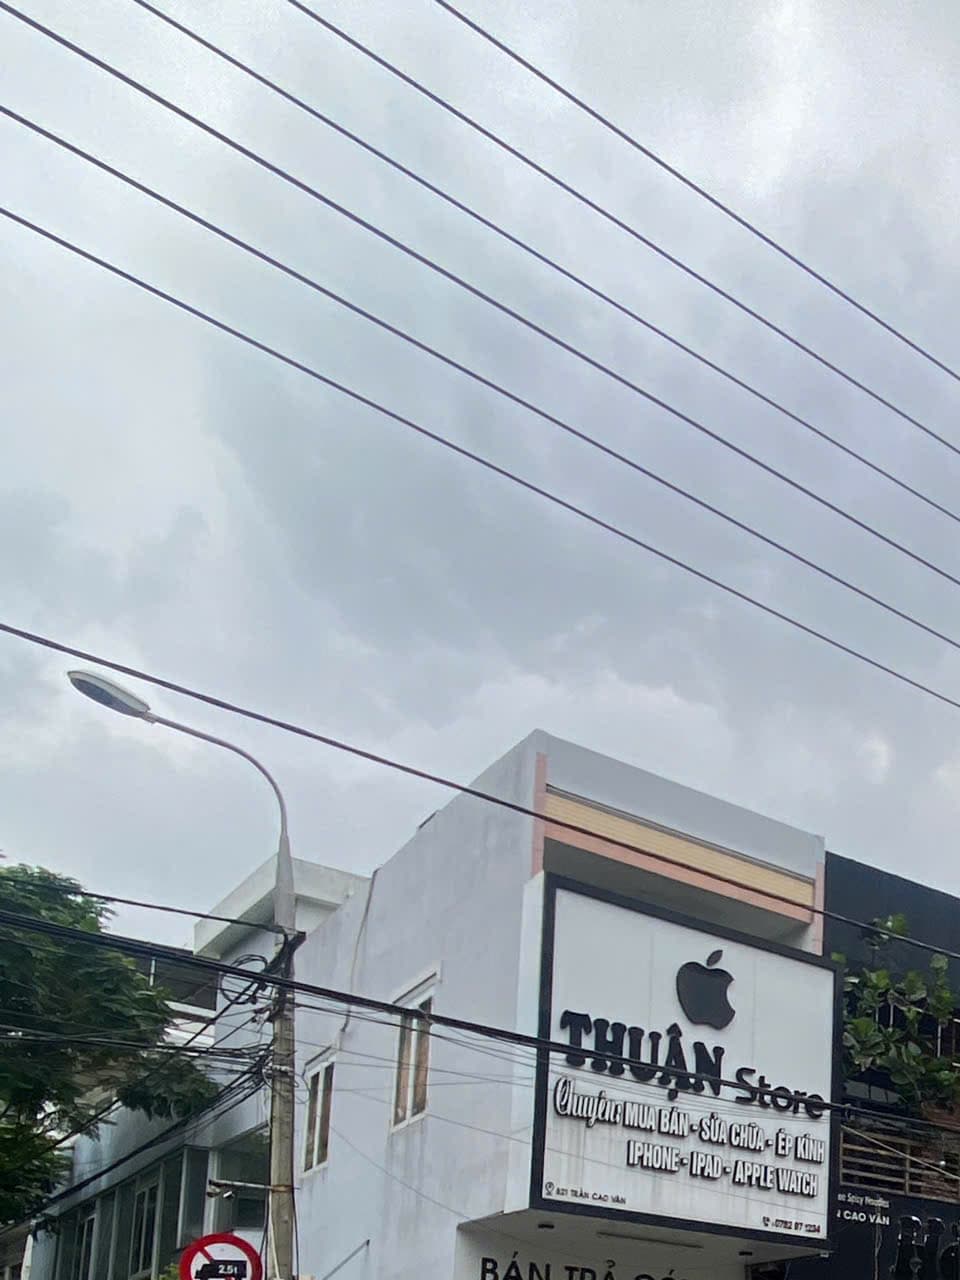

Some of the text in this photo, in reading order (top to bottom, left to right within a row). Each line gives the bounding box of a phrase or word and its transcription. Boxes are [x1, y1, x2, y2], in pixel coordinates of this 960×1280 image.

[560, 1010, 825, 1119] THUẬN Store
[622, 1101, 656, 1131] MUA
[658, 1106, 689, 1138] BÁN
[700, 1112, 727, 1144] SỬA
[729, 1122, 764, 1151] CHỮA
[775, 1128, 793, 1156] ÉP
[795, 1133, 825, 1163] KÍNH
[592, 1193, 609, 1202] CAO
[627, 1140, 680, 1173] IPHONE
[690, 1151, 722, 1179] IPAD
[733, 1160, 775, 1190] APPLE
[776, 1167, 818, 1198] WATCH
[843, 1210, 866, 1222] CAO
